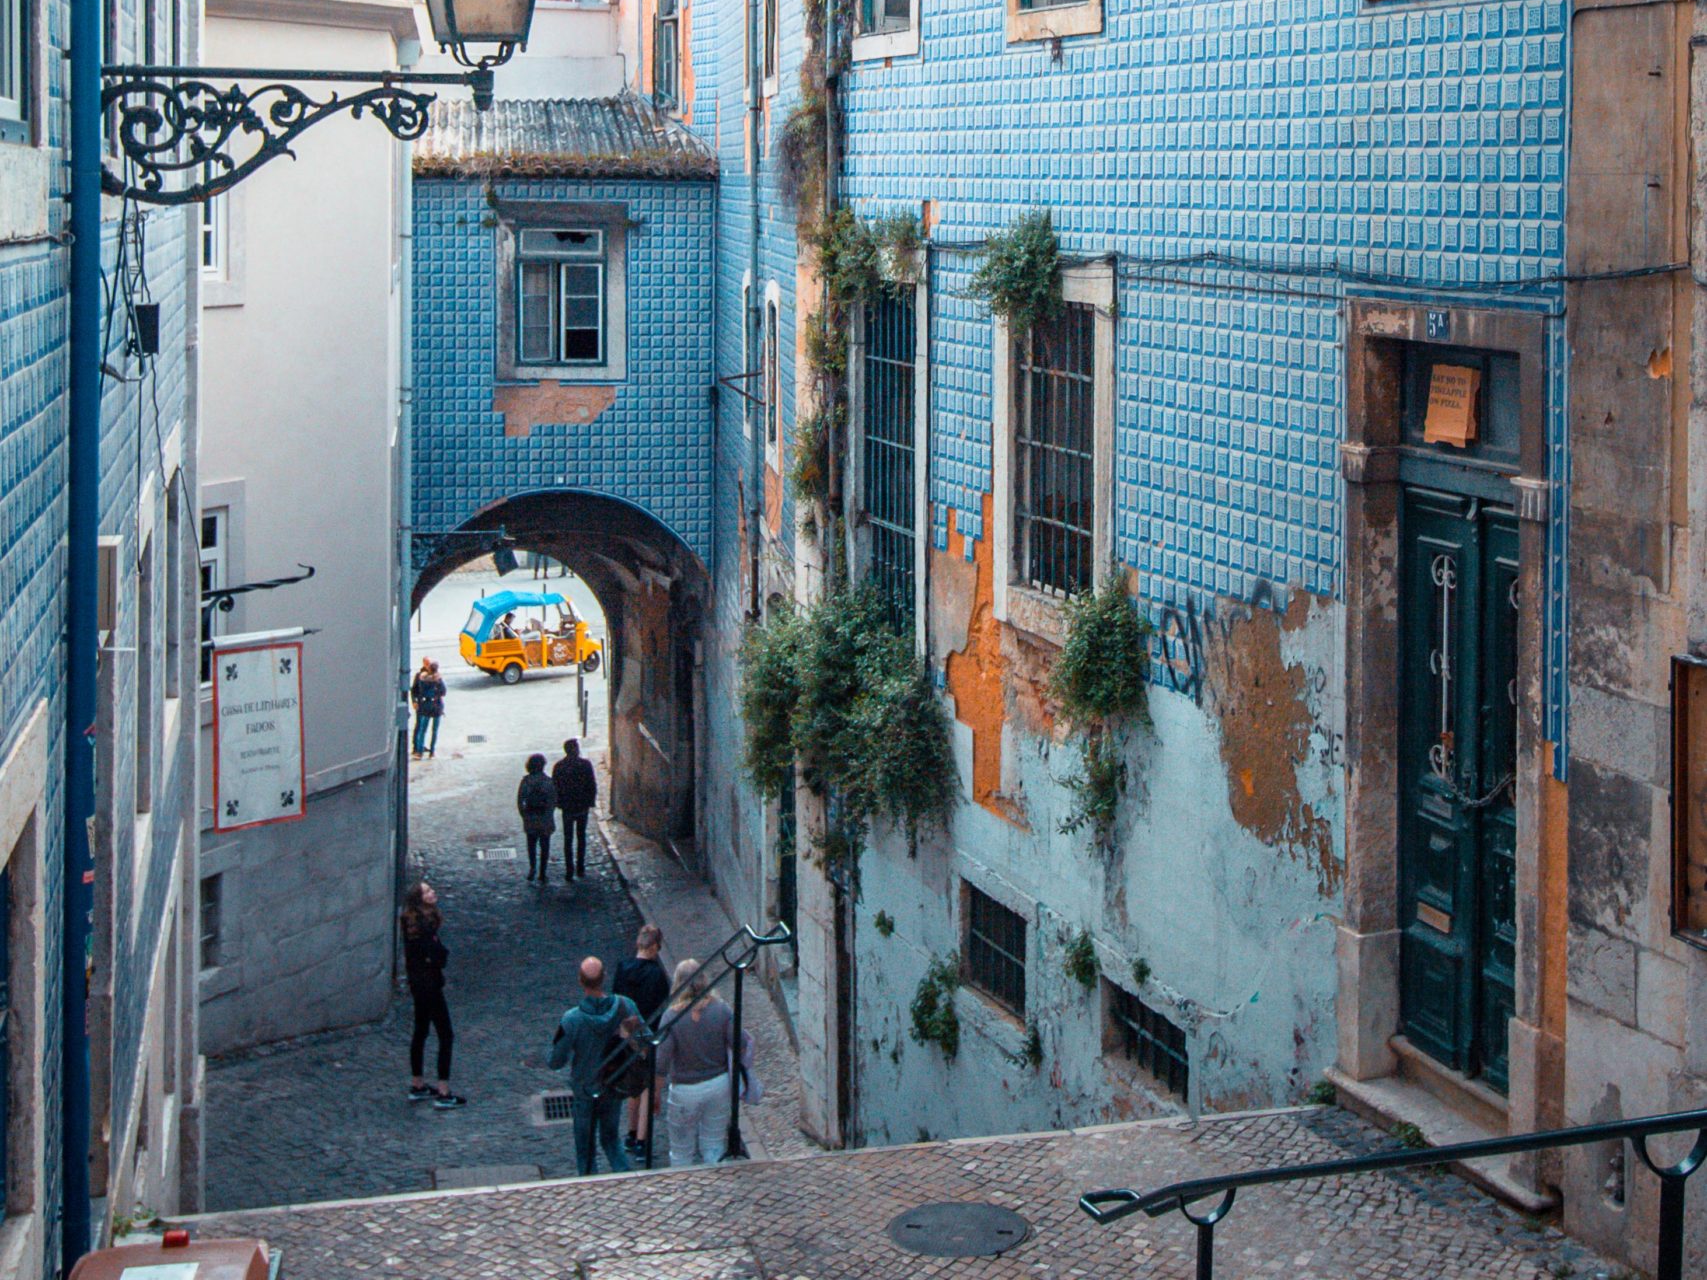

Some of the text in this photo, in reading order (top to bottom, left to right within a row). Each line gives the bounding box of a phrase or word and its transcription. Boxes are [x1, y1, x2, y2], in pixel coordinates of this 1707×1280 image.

[1446, 376, 1456, 384] NO
[1457, 377, 1466, 386] TO
[1430, 385, 1467, 398] PINEAPPLE
[1429, 397, 1439, 405] ON
[244, 702, 254, 713] DE
